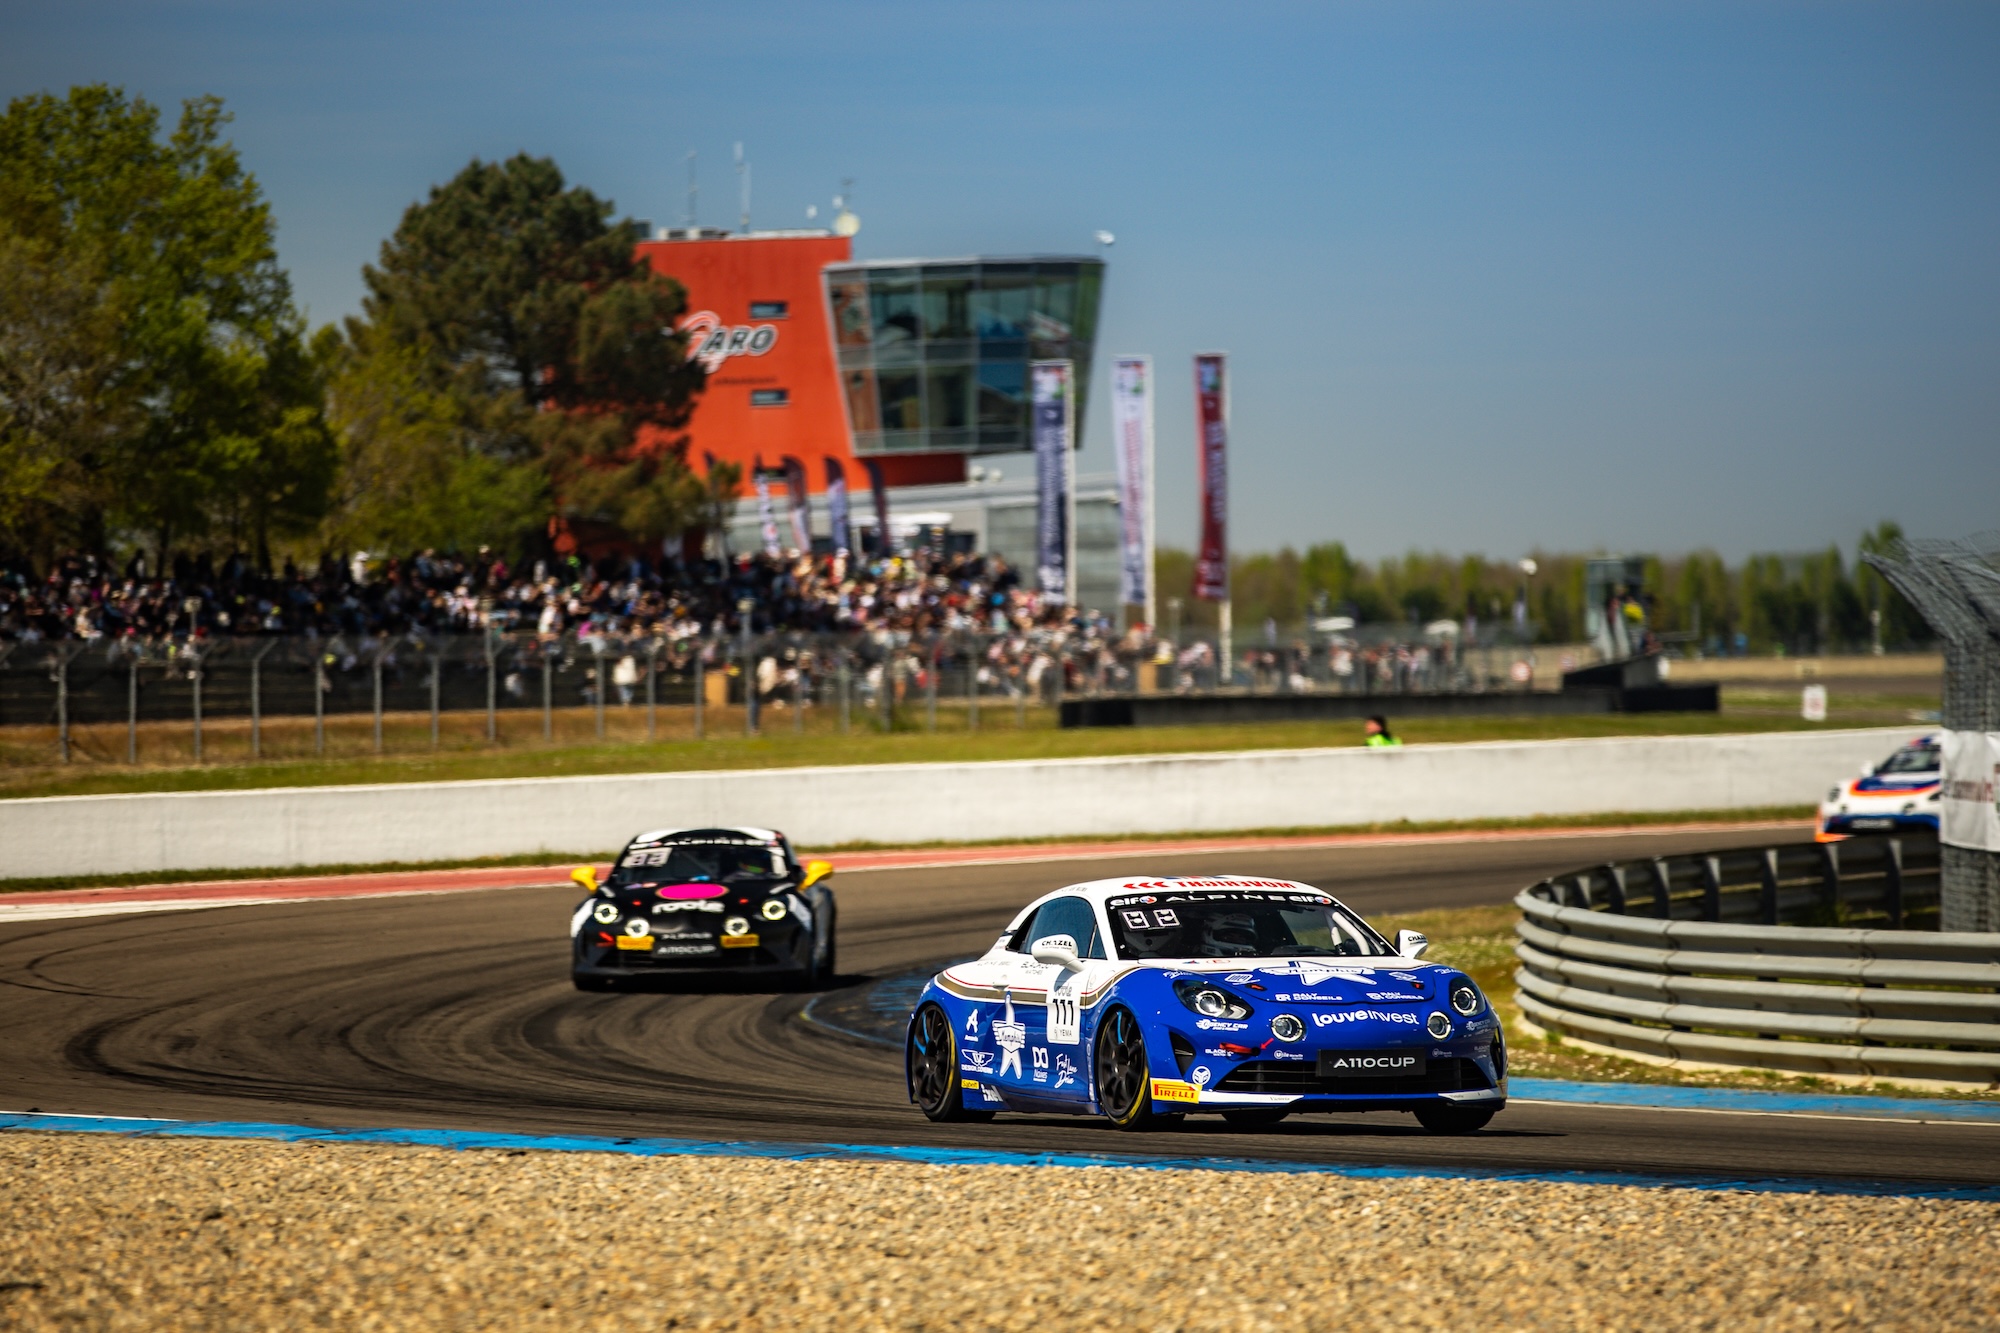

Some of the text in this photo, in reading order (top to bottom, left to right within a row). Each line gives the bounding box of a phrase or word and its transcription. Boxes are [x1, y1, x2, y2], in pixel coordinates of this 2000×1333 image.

[1110, 894, 1316, 906] elf ALPINE elf
[1053, 998, 1074, 1026] 111
[1333, 1056, 1416, 1068] A110CUP
[1154, 1083, 1195, 1100] PIRELLI
